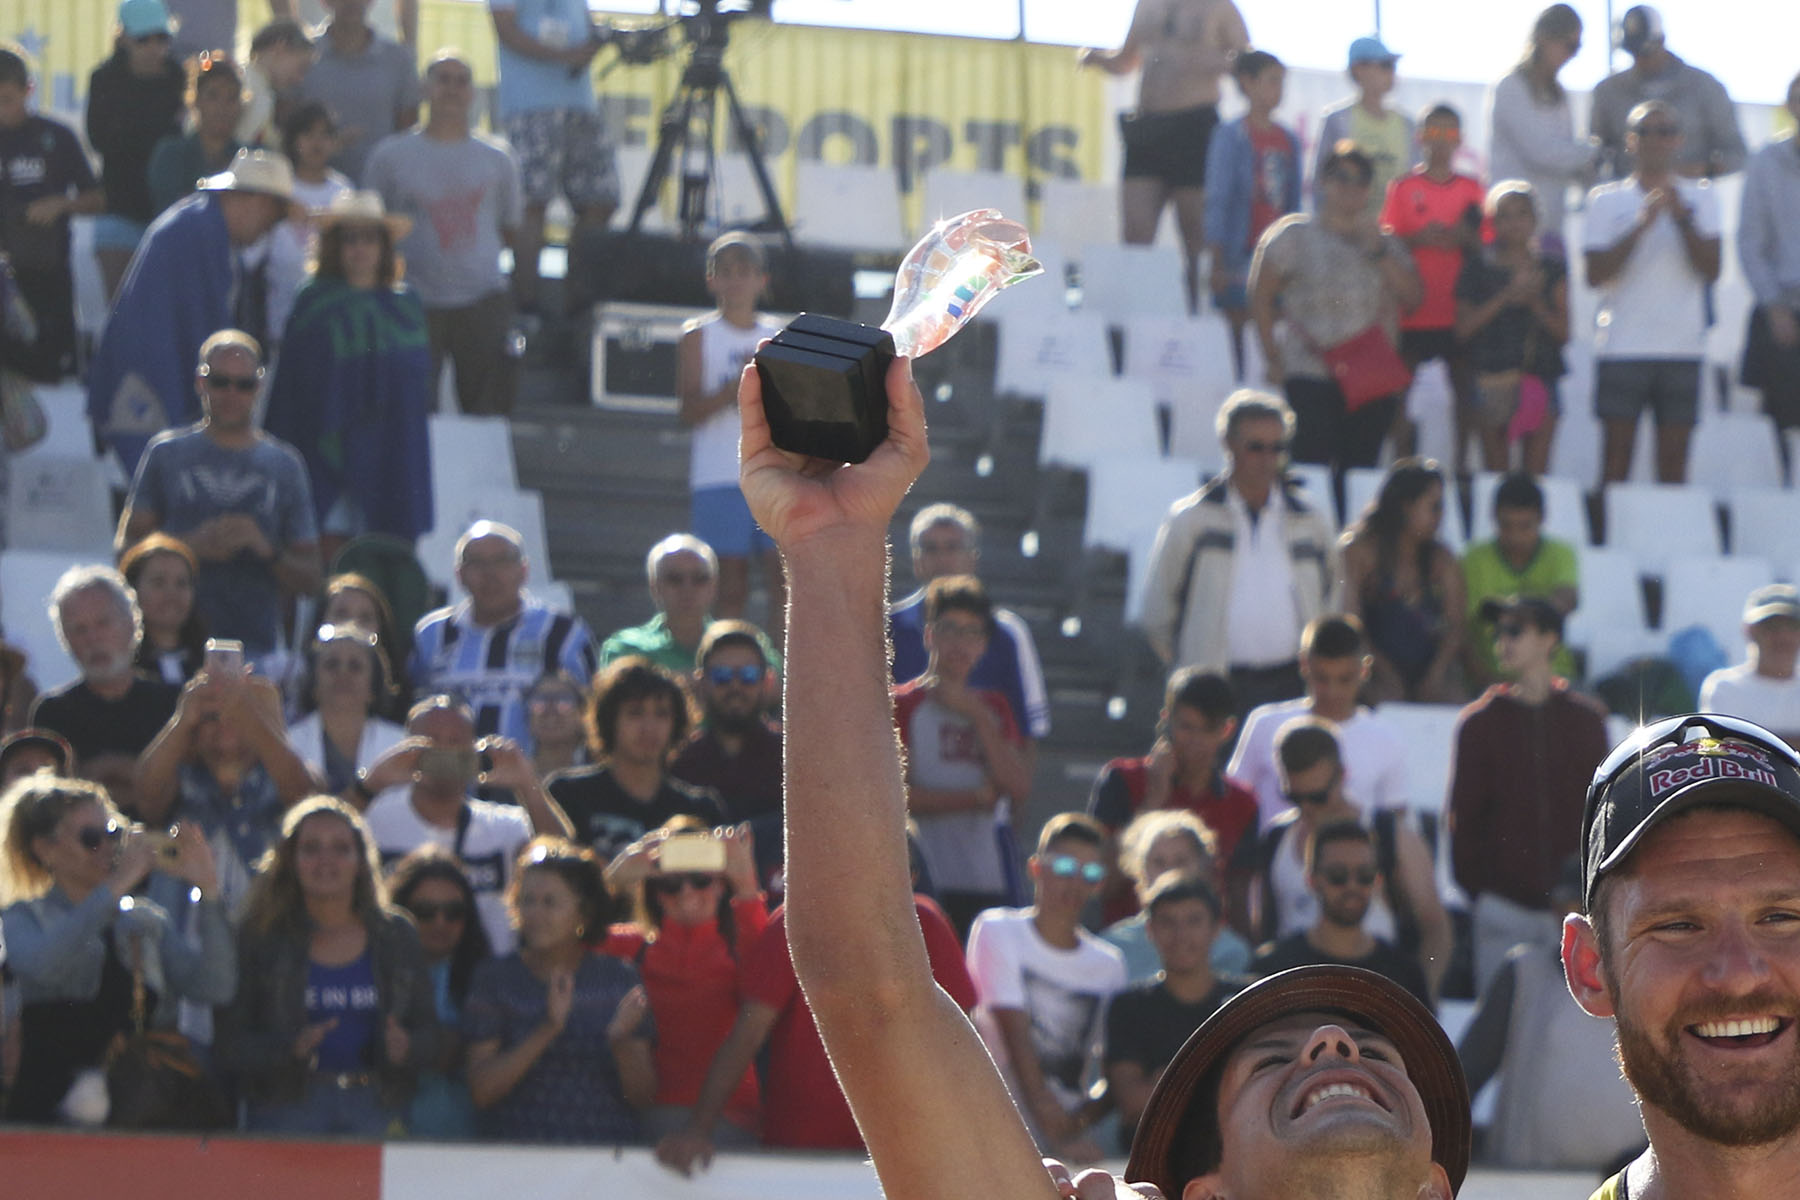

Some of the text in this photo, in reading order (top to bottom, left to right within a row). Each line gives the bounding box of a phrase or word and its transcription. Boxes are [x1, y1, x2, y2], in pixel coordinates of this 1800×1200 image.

[662, 103, 1081, 198] PORTS
[1650, 758, 1713, 797] Red
[321, 987, 348, 1010] IN
